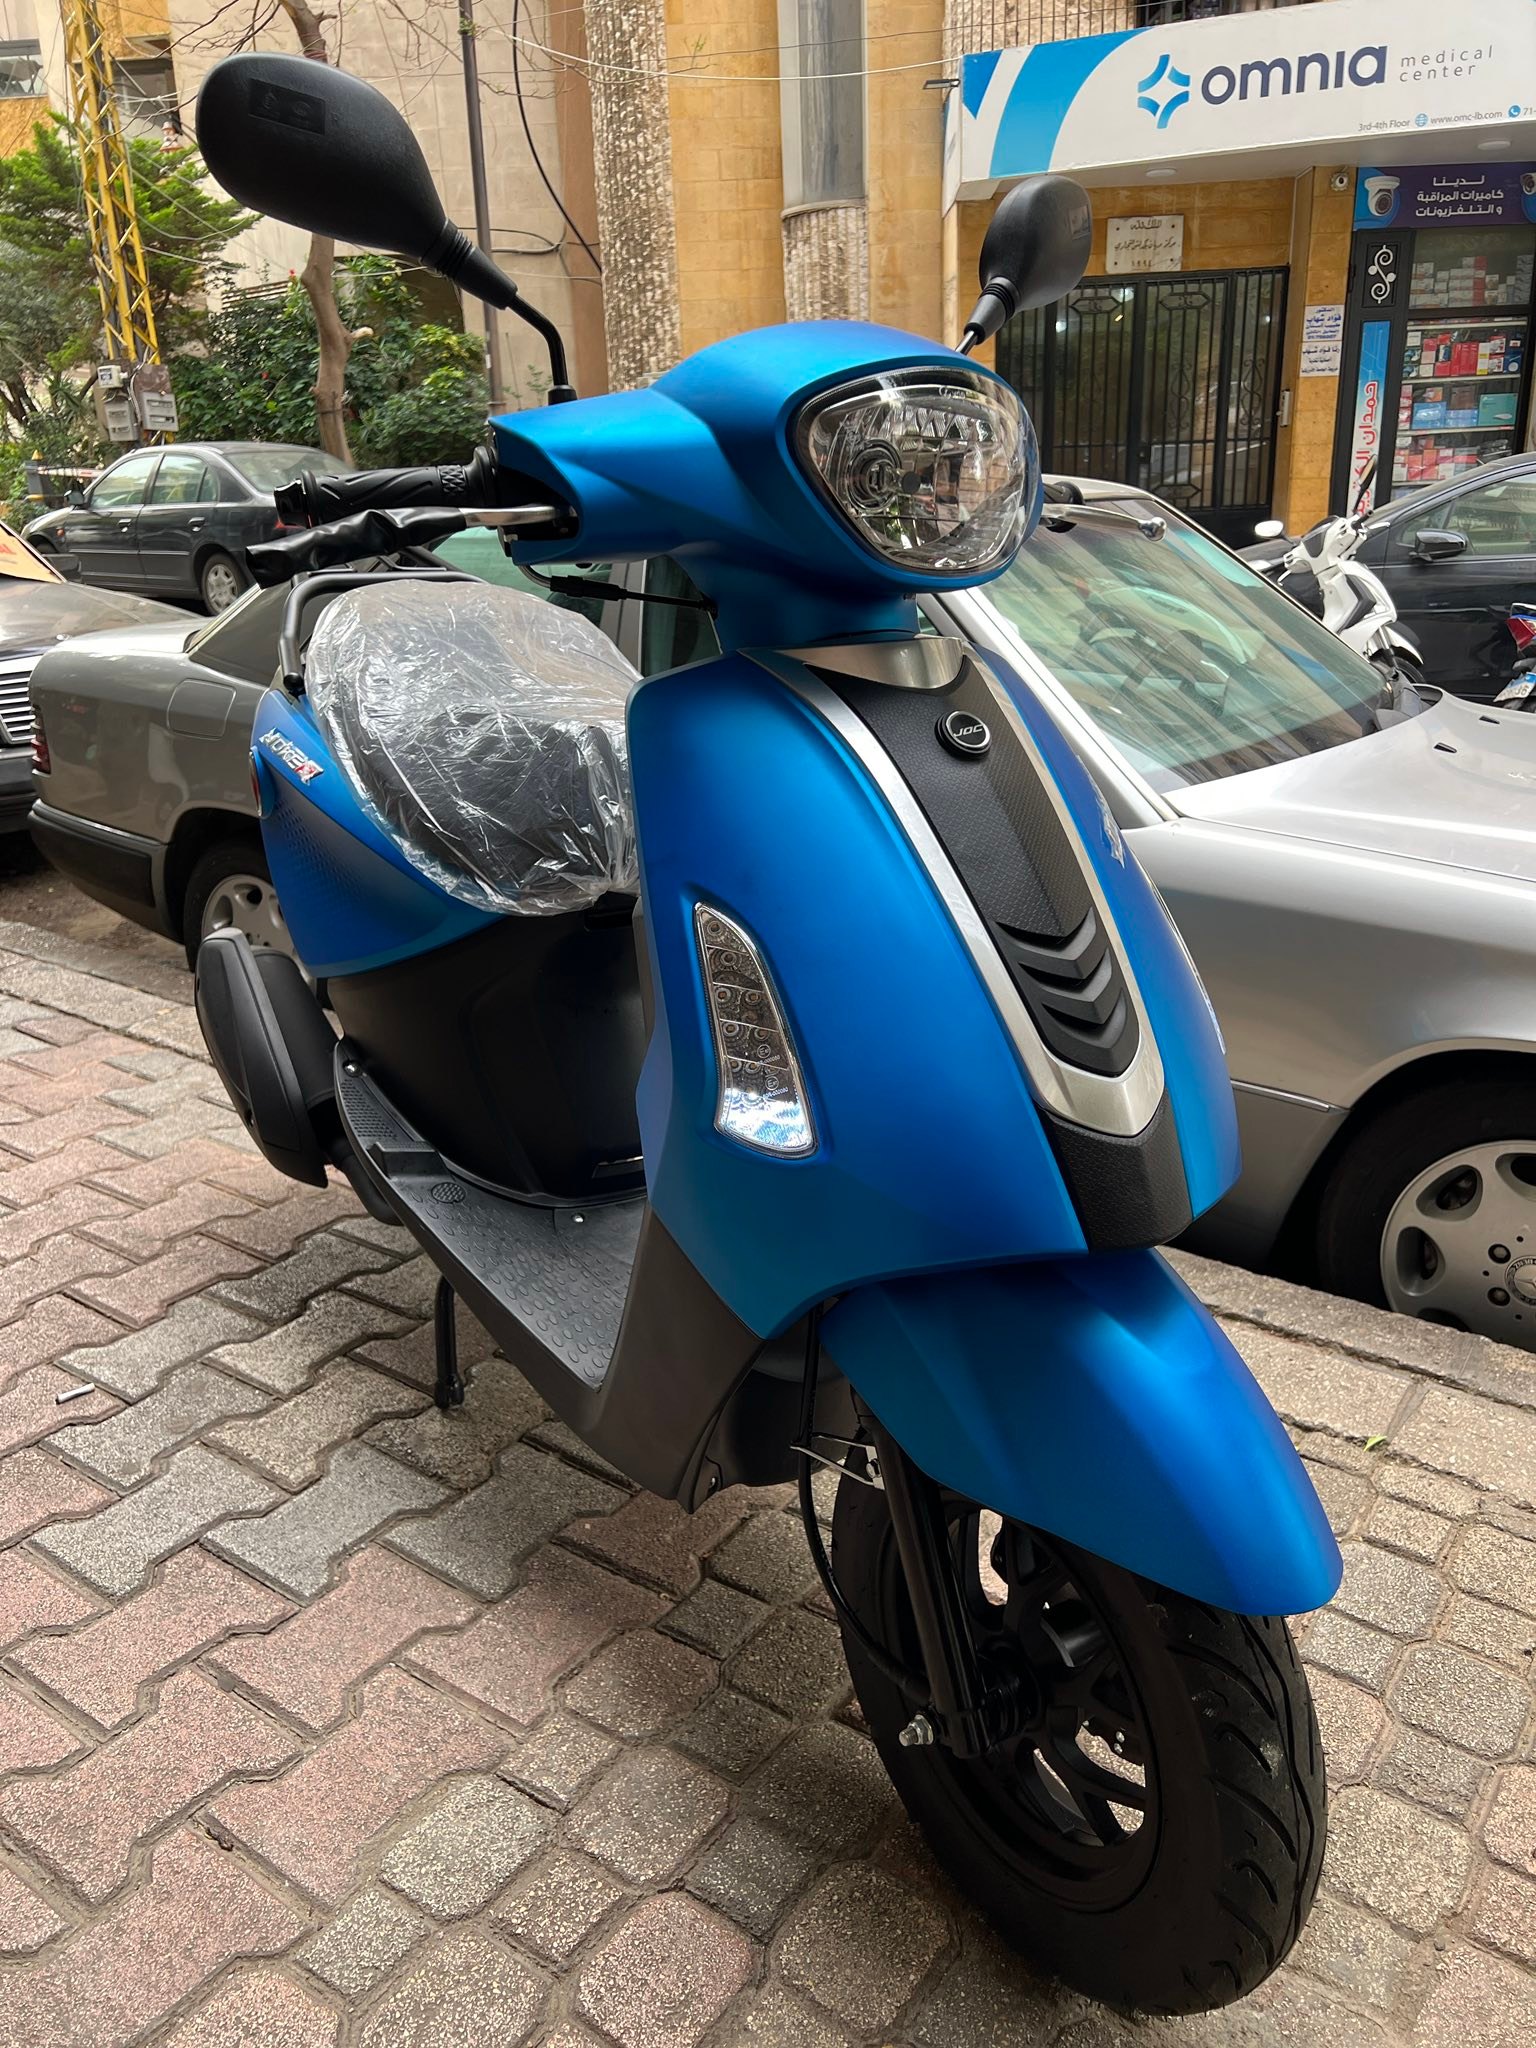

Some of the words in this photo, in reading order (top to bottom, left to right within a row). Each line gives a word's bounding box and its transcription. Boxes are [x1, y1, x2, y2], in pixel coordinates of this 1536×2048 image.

[1401, 45, 1493, 67] medical
[1201, 46, 1388, 105] omnia
[1399, 62, 1476, 82] center
[1430, 111, 1503, 125] www.omc-lb.com
[1358, 120, 1388, 132] 3rd-4th
[1389, 119, 1411, 129] Floor
[1433, 175, 1486, 188] لدينا
[1417, 190, 1460, 203] المراقبة
[1460, 189, 1504, 201] كاميرات
[1415, 203, 1495, 218] التلفزيونات
[1496, 205, 1503, 216] و
[1359, 382, 1377, 445] حمدان
